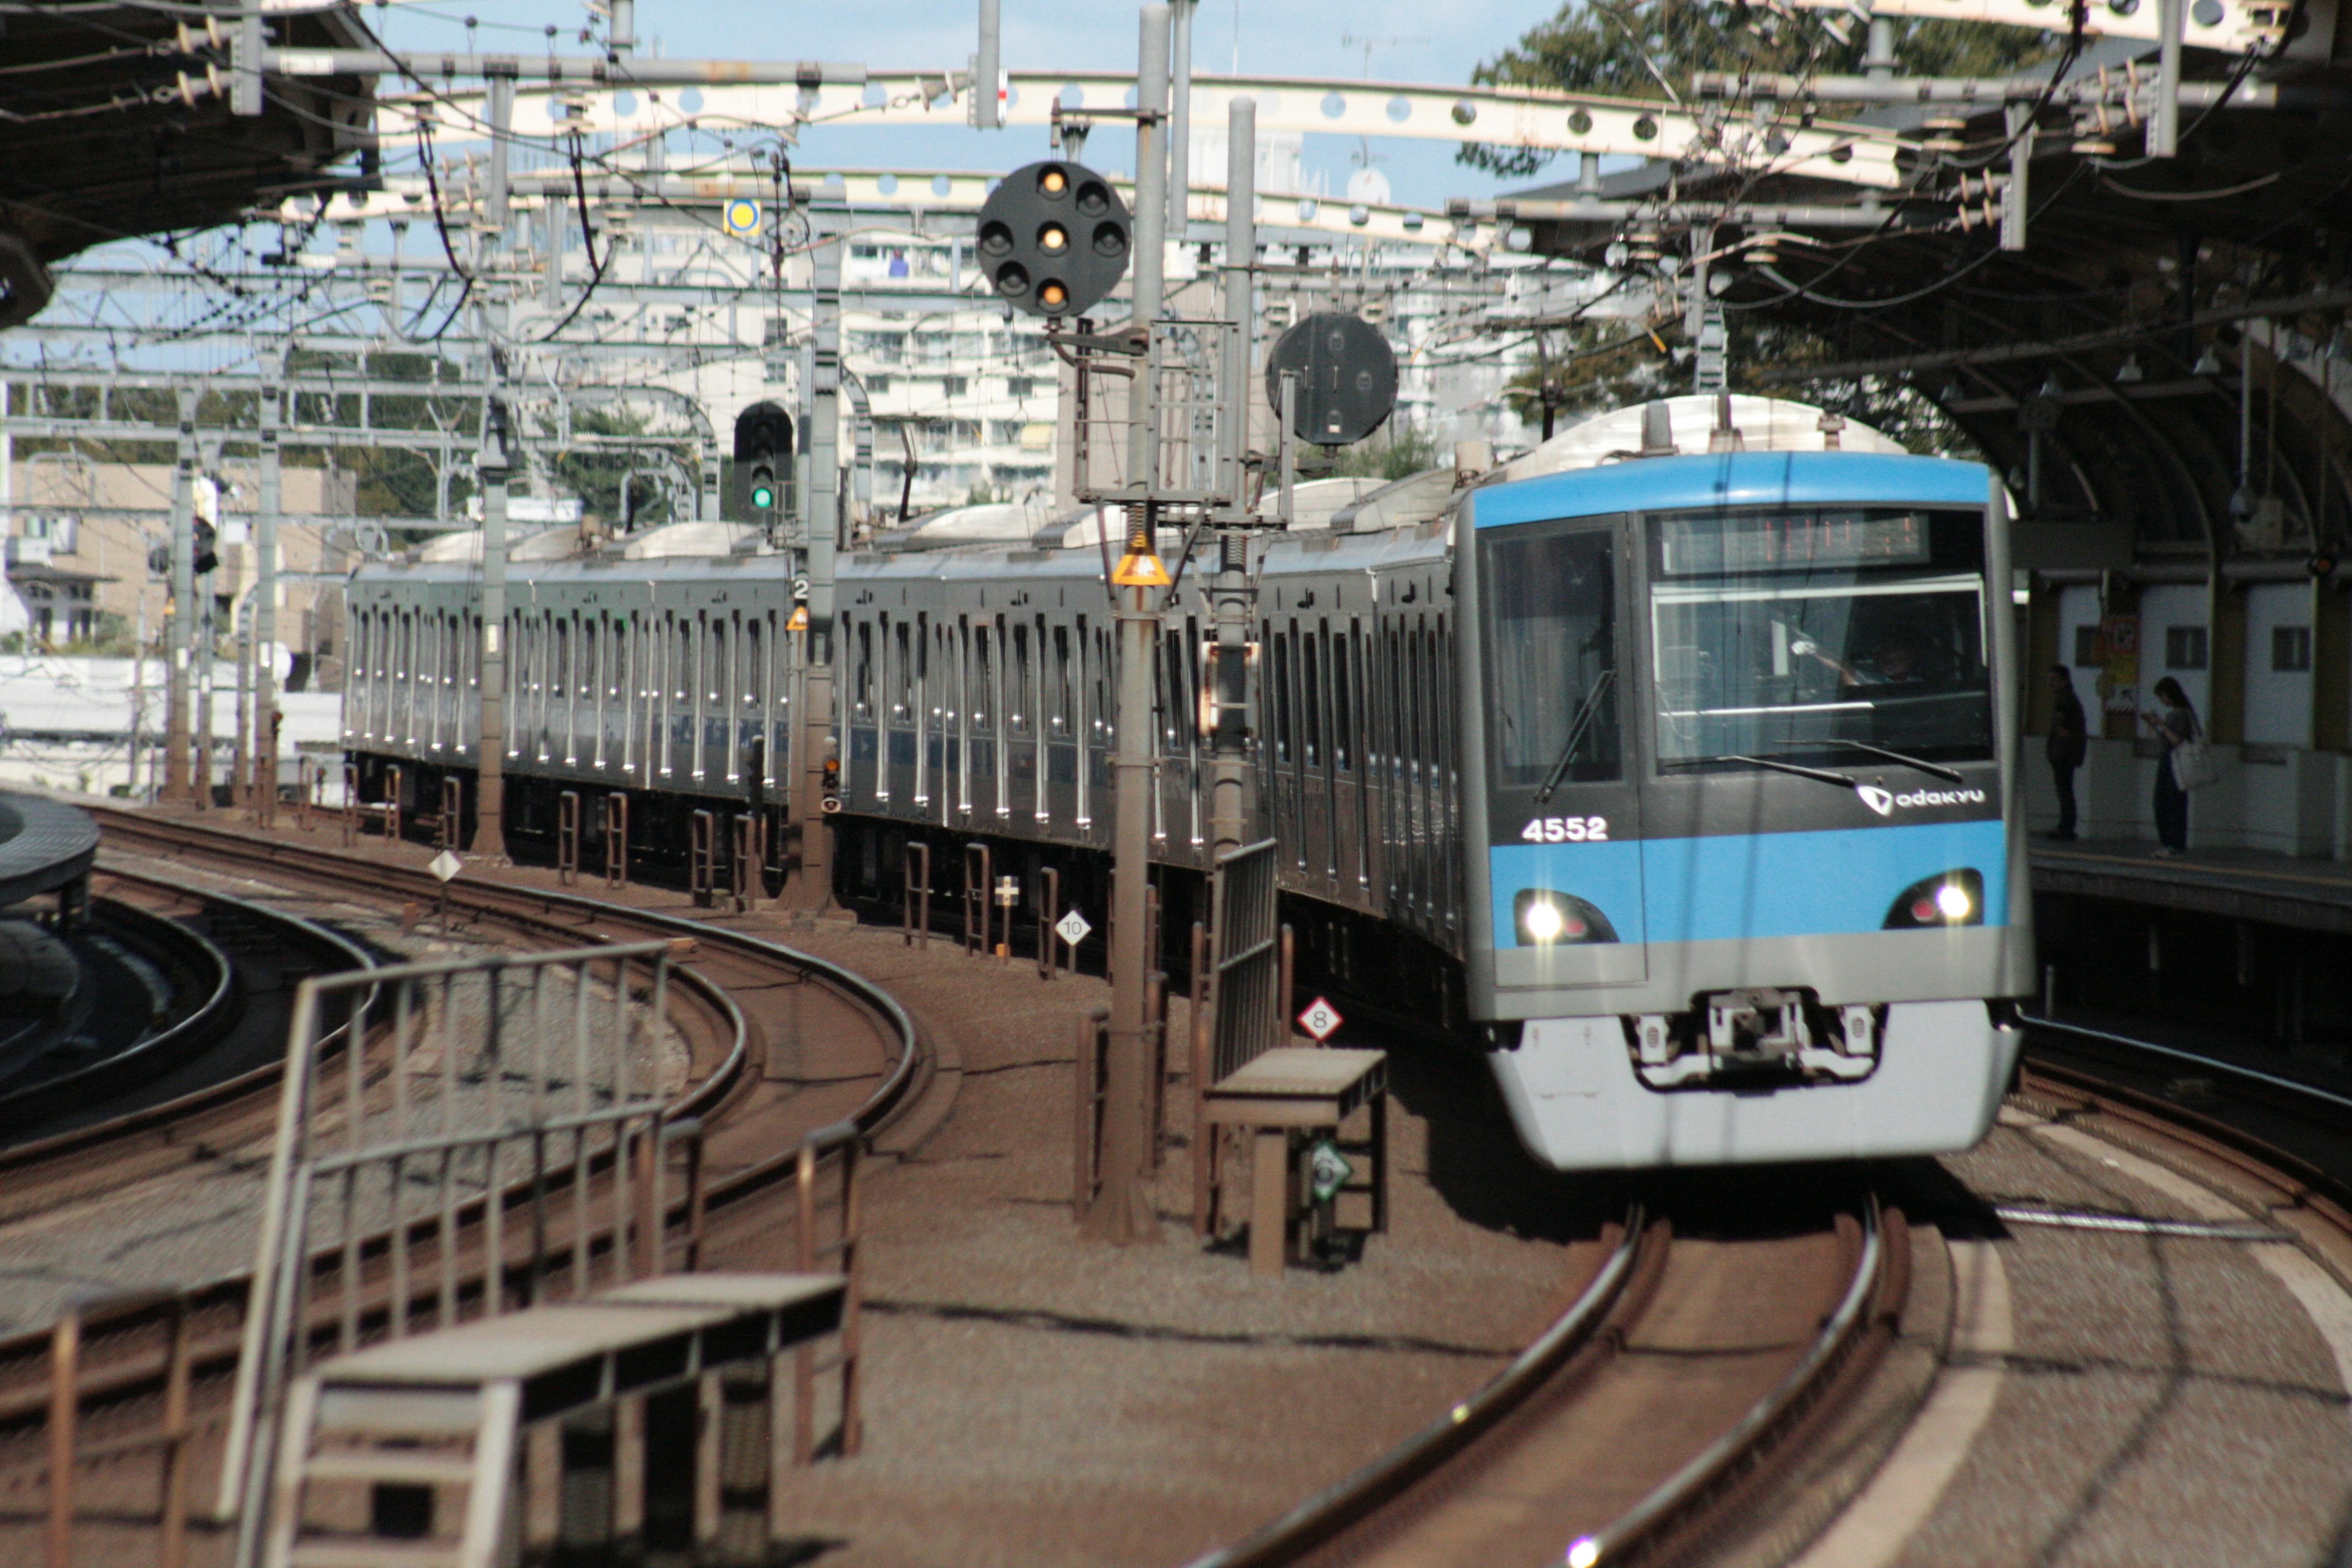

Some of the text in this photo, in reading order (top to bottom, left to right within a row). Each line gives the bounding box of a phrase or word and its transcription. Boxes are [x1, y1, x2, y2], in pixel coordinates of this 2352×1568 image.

[794, 579, 809, 599] 2
[1895, 788, 1986, 808] odakyu
[1521, 816, 1608, 842] 4552
[1063, 921, 1082, 935] 10
[1313, 1011, 1327, 1028] 8
